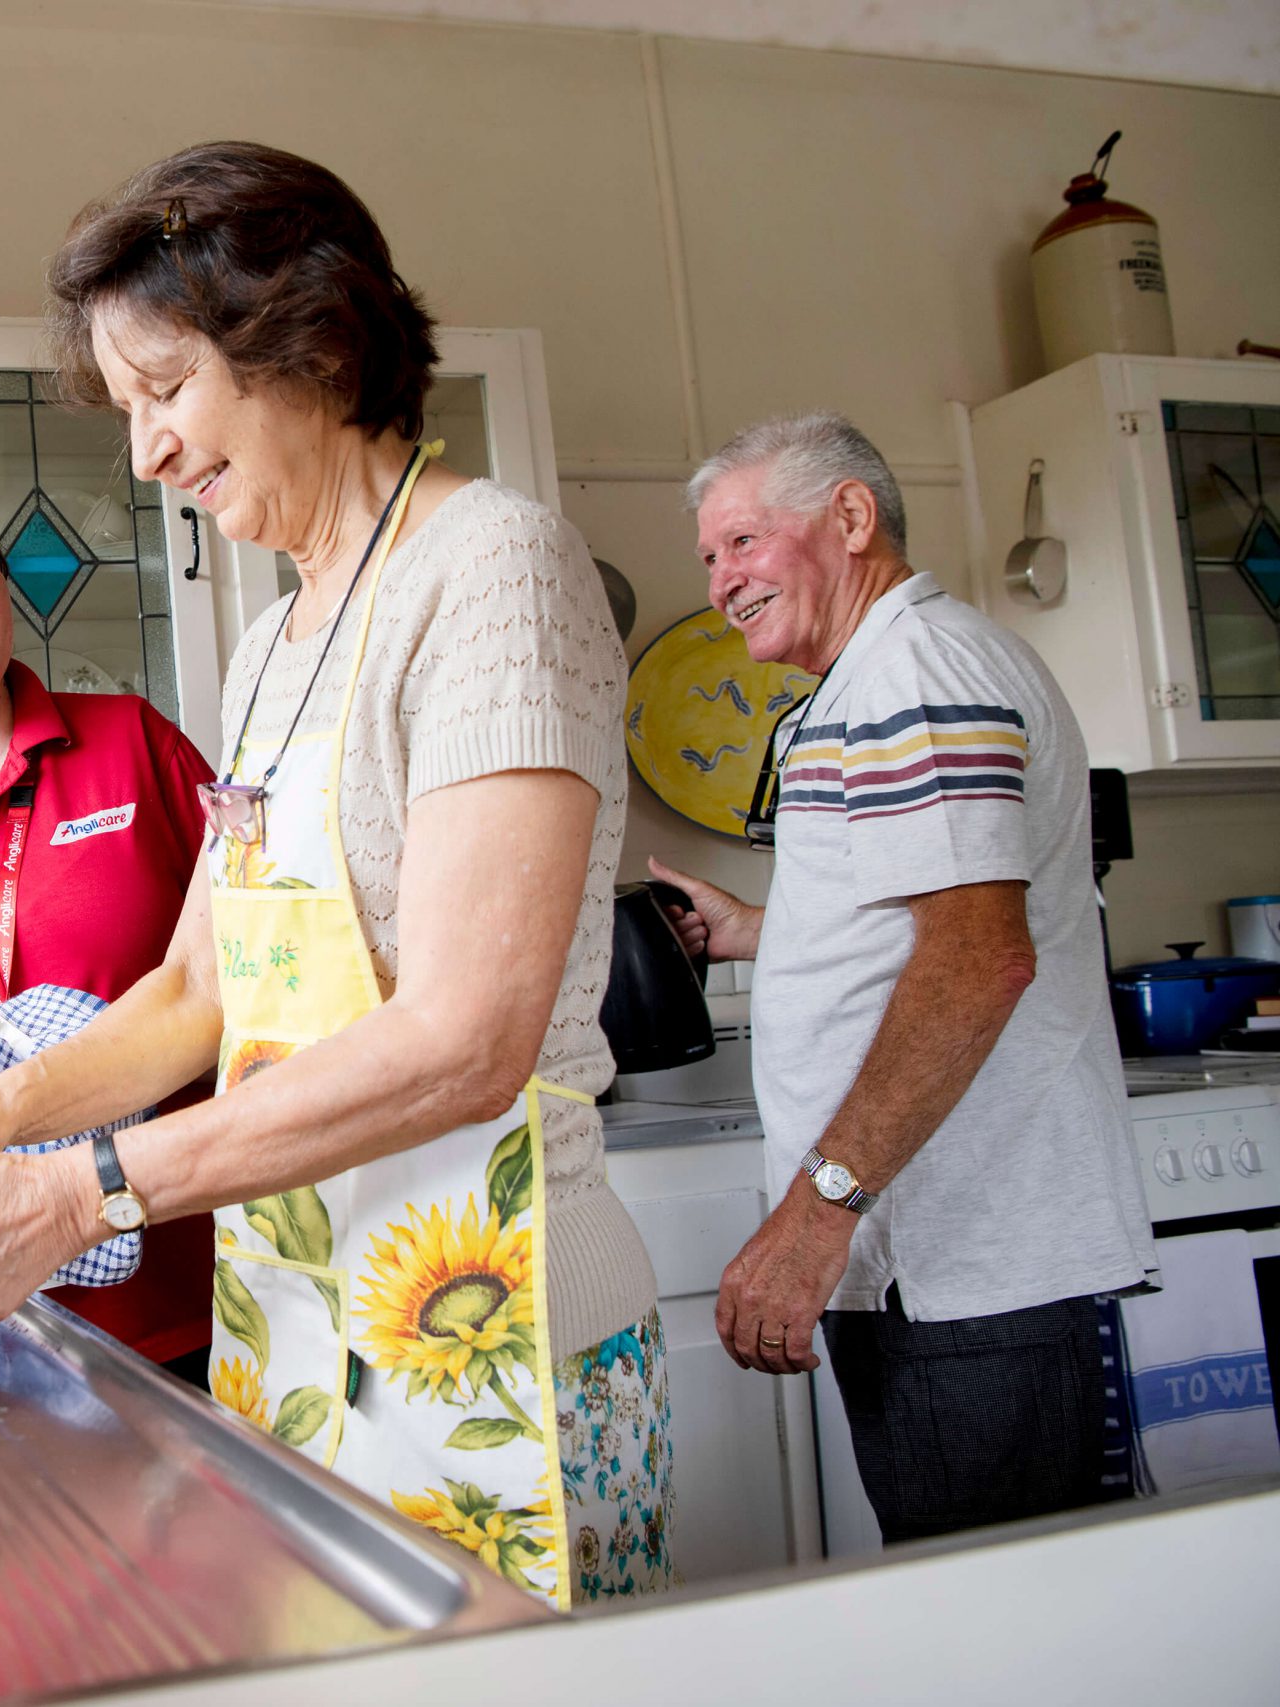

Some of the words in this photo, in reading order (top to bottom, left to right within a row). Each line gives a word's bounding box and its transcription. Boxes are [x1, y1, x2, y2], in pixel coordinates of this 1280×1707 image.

[3, 823, 24, 872] Anglicare
[61, 812, 127, 838] Anglicare
[1164, 1362, 1273, 1409] TOWE
